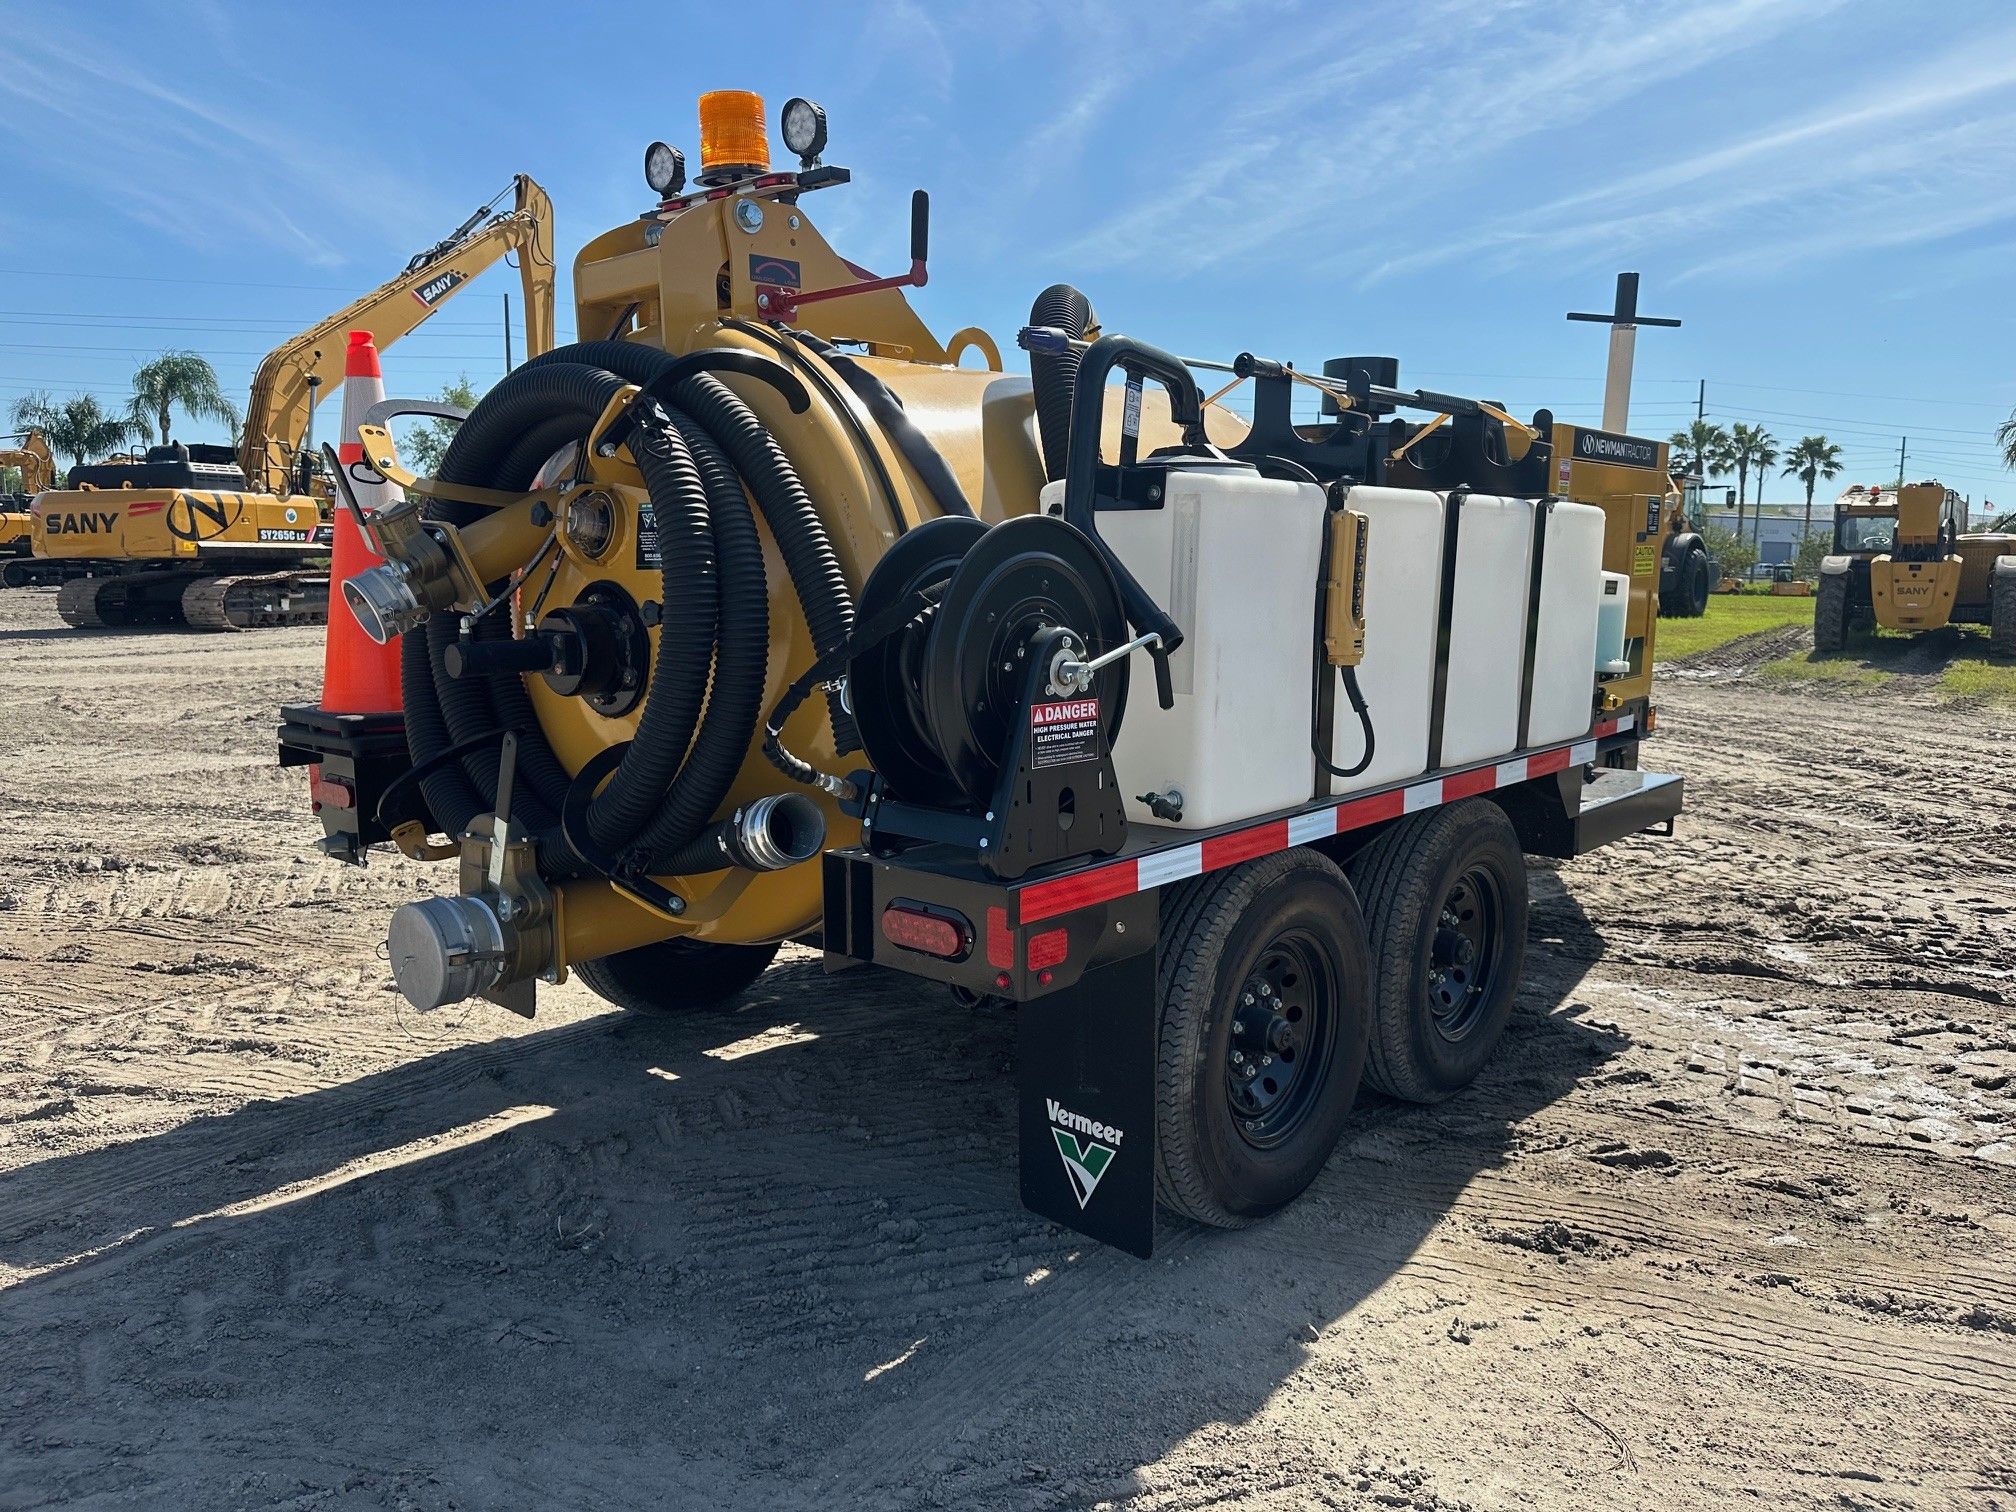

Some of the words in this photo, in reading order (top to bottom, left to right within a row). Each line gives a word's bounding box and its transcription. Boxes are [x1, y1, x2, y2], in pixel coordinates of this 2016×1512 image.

[423, 274, 451, 302] SANY
[46, 512, 119, 535] SANY
[260, 529, 296, 541] SY265C
[1896, 587, 1929, 595] SANY
[1045, 703, 1096, 721] DANGER
[1034, 726, 1048, 734] HIGH
[1049, 722, 1078, 732] PRESSURE
[1079, 720, 1096, 728] WATER
[1037, 733, 1071, 742] ELECTRICAL
[1072, 730, 1093, 738] DANGER
[1046, 1098, 1124, 1146] Vermeer
